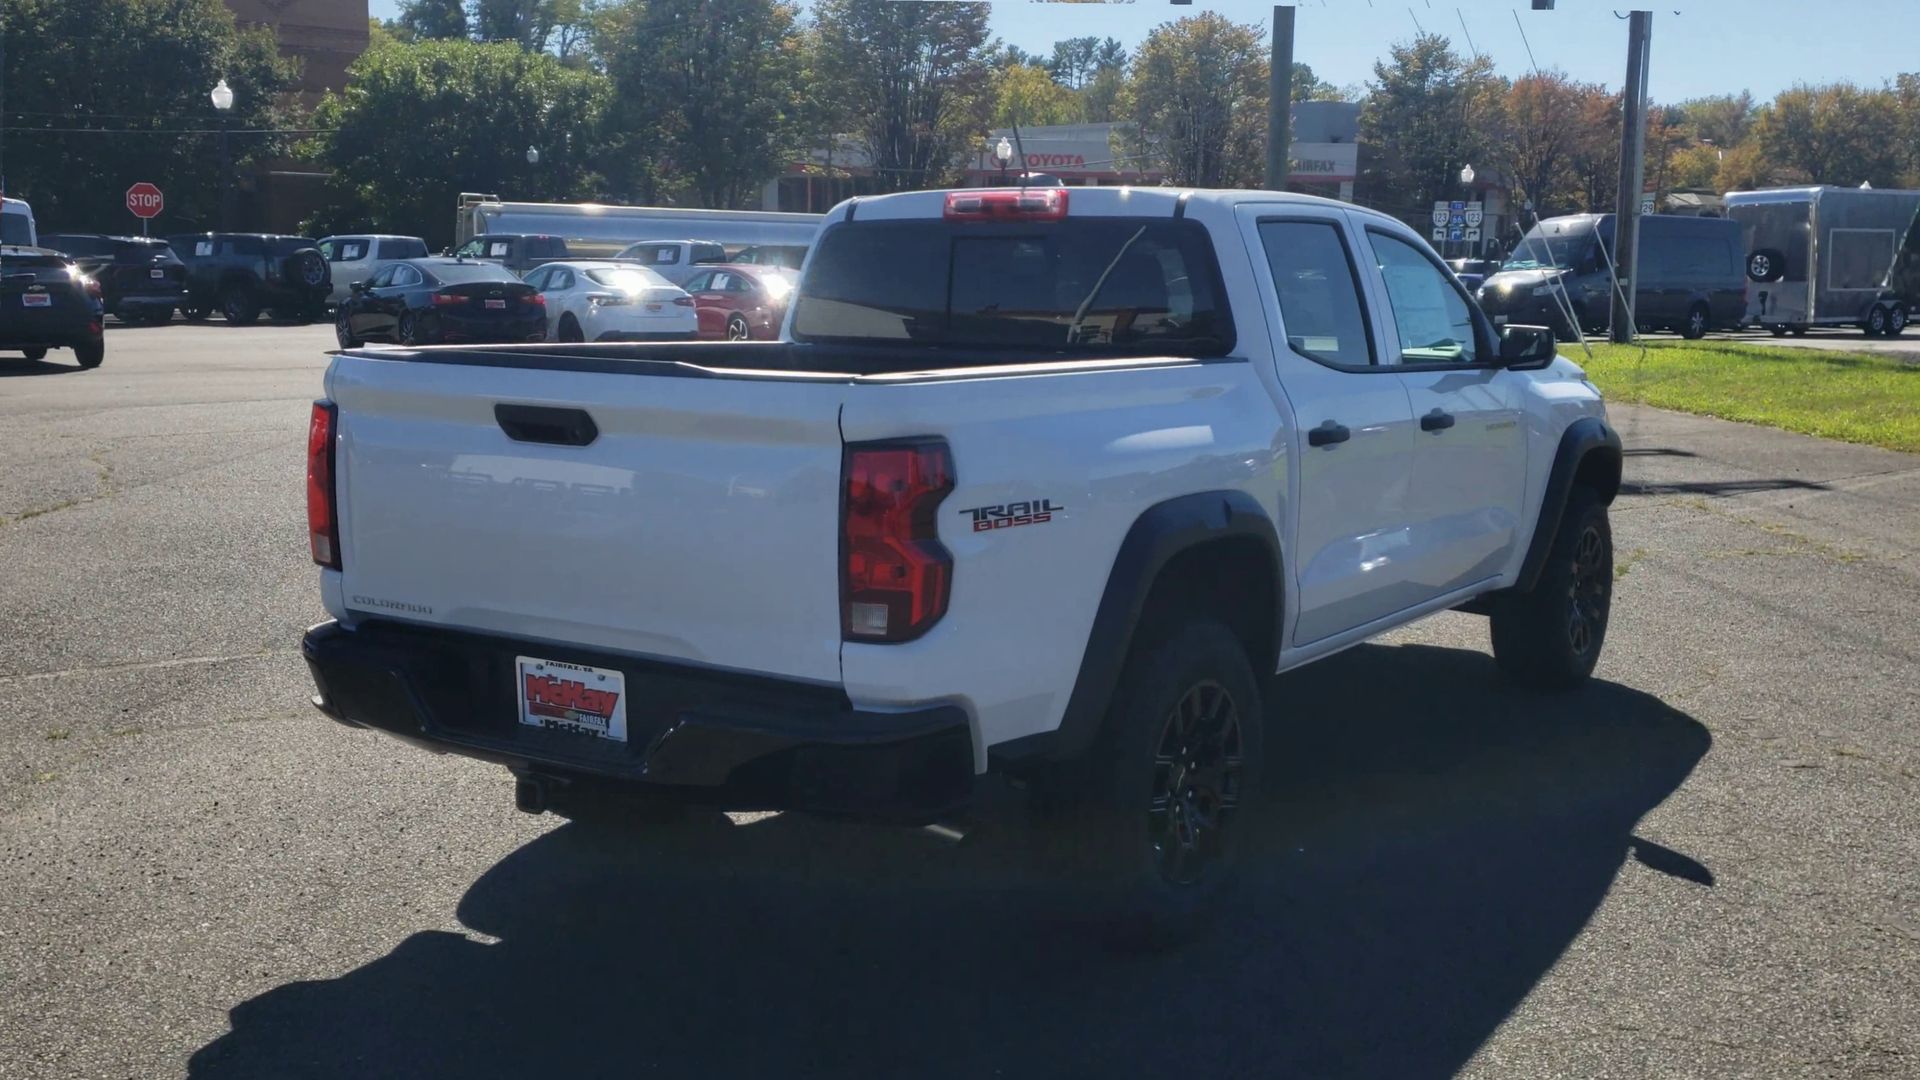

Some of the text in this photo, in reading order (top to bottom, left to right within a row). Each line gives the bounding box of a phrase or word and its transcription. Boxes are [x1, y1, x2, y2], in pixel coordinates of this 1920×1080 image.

[129, 193, 161, 207] STOP
[1642, 203, 1654, 214] 29
[1434, 212, 1447, 223] 123
[1452, 214, 1463, 224] 66
[1467, 212, 1481, 223] 123
[959, 499, 1064, 520] TRAIL
[973, 511, 1052, 532] BOSS
[526, 673, 619, 720] McKay
[579, 713, 607, 727] FAIRFAX
